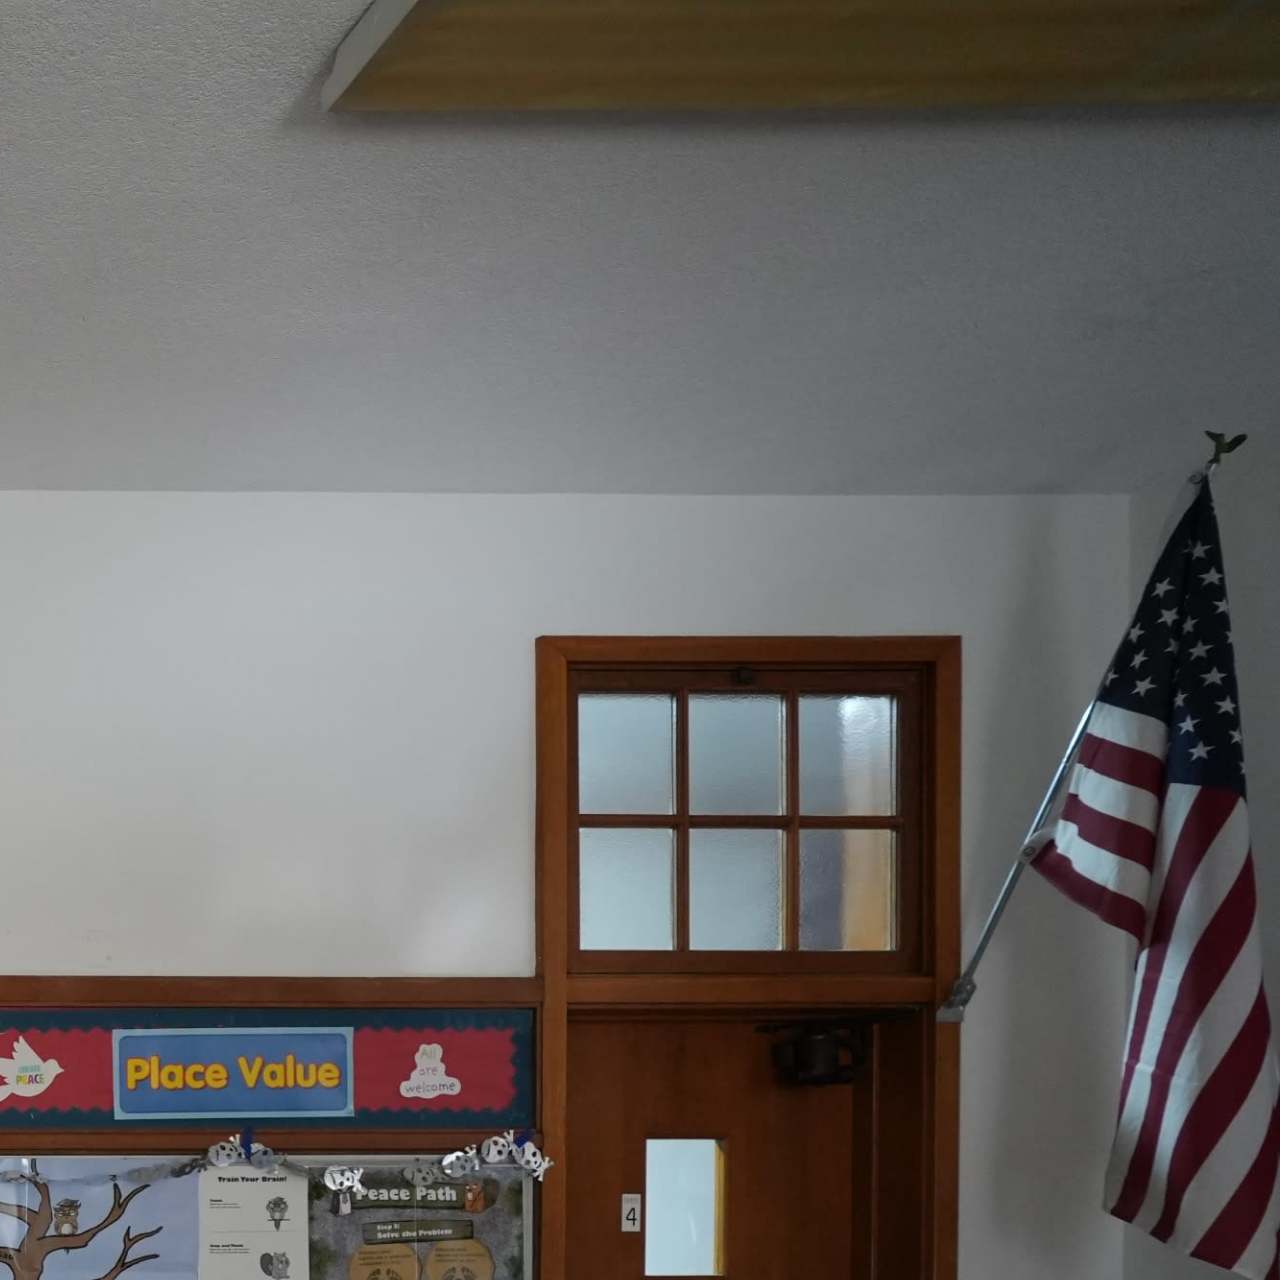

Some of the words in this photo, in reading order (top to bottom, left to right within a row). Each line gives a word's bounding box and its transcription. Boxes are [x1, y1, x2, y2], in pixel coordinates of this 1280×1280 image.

[420, 1048, 437, 1059] All
[126, 1055, 229, 1091] Place
[238, 1055, 341, 1090] Value
[419, 1066, 438, 1076] are
[16, 1074, 44, 1085] PEACE
[405, 1080, 457, 1093] welcome
[261, 1175, 287, 1183] Brain!
[356, 1186, 411, 1202] Peace
[416, 1186, 457, 1201] Path
[626, 1207, 637, 1227] 4
